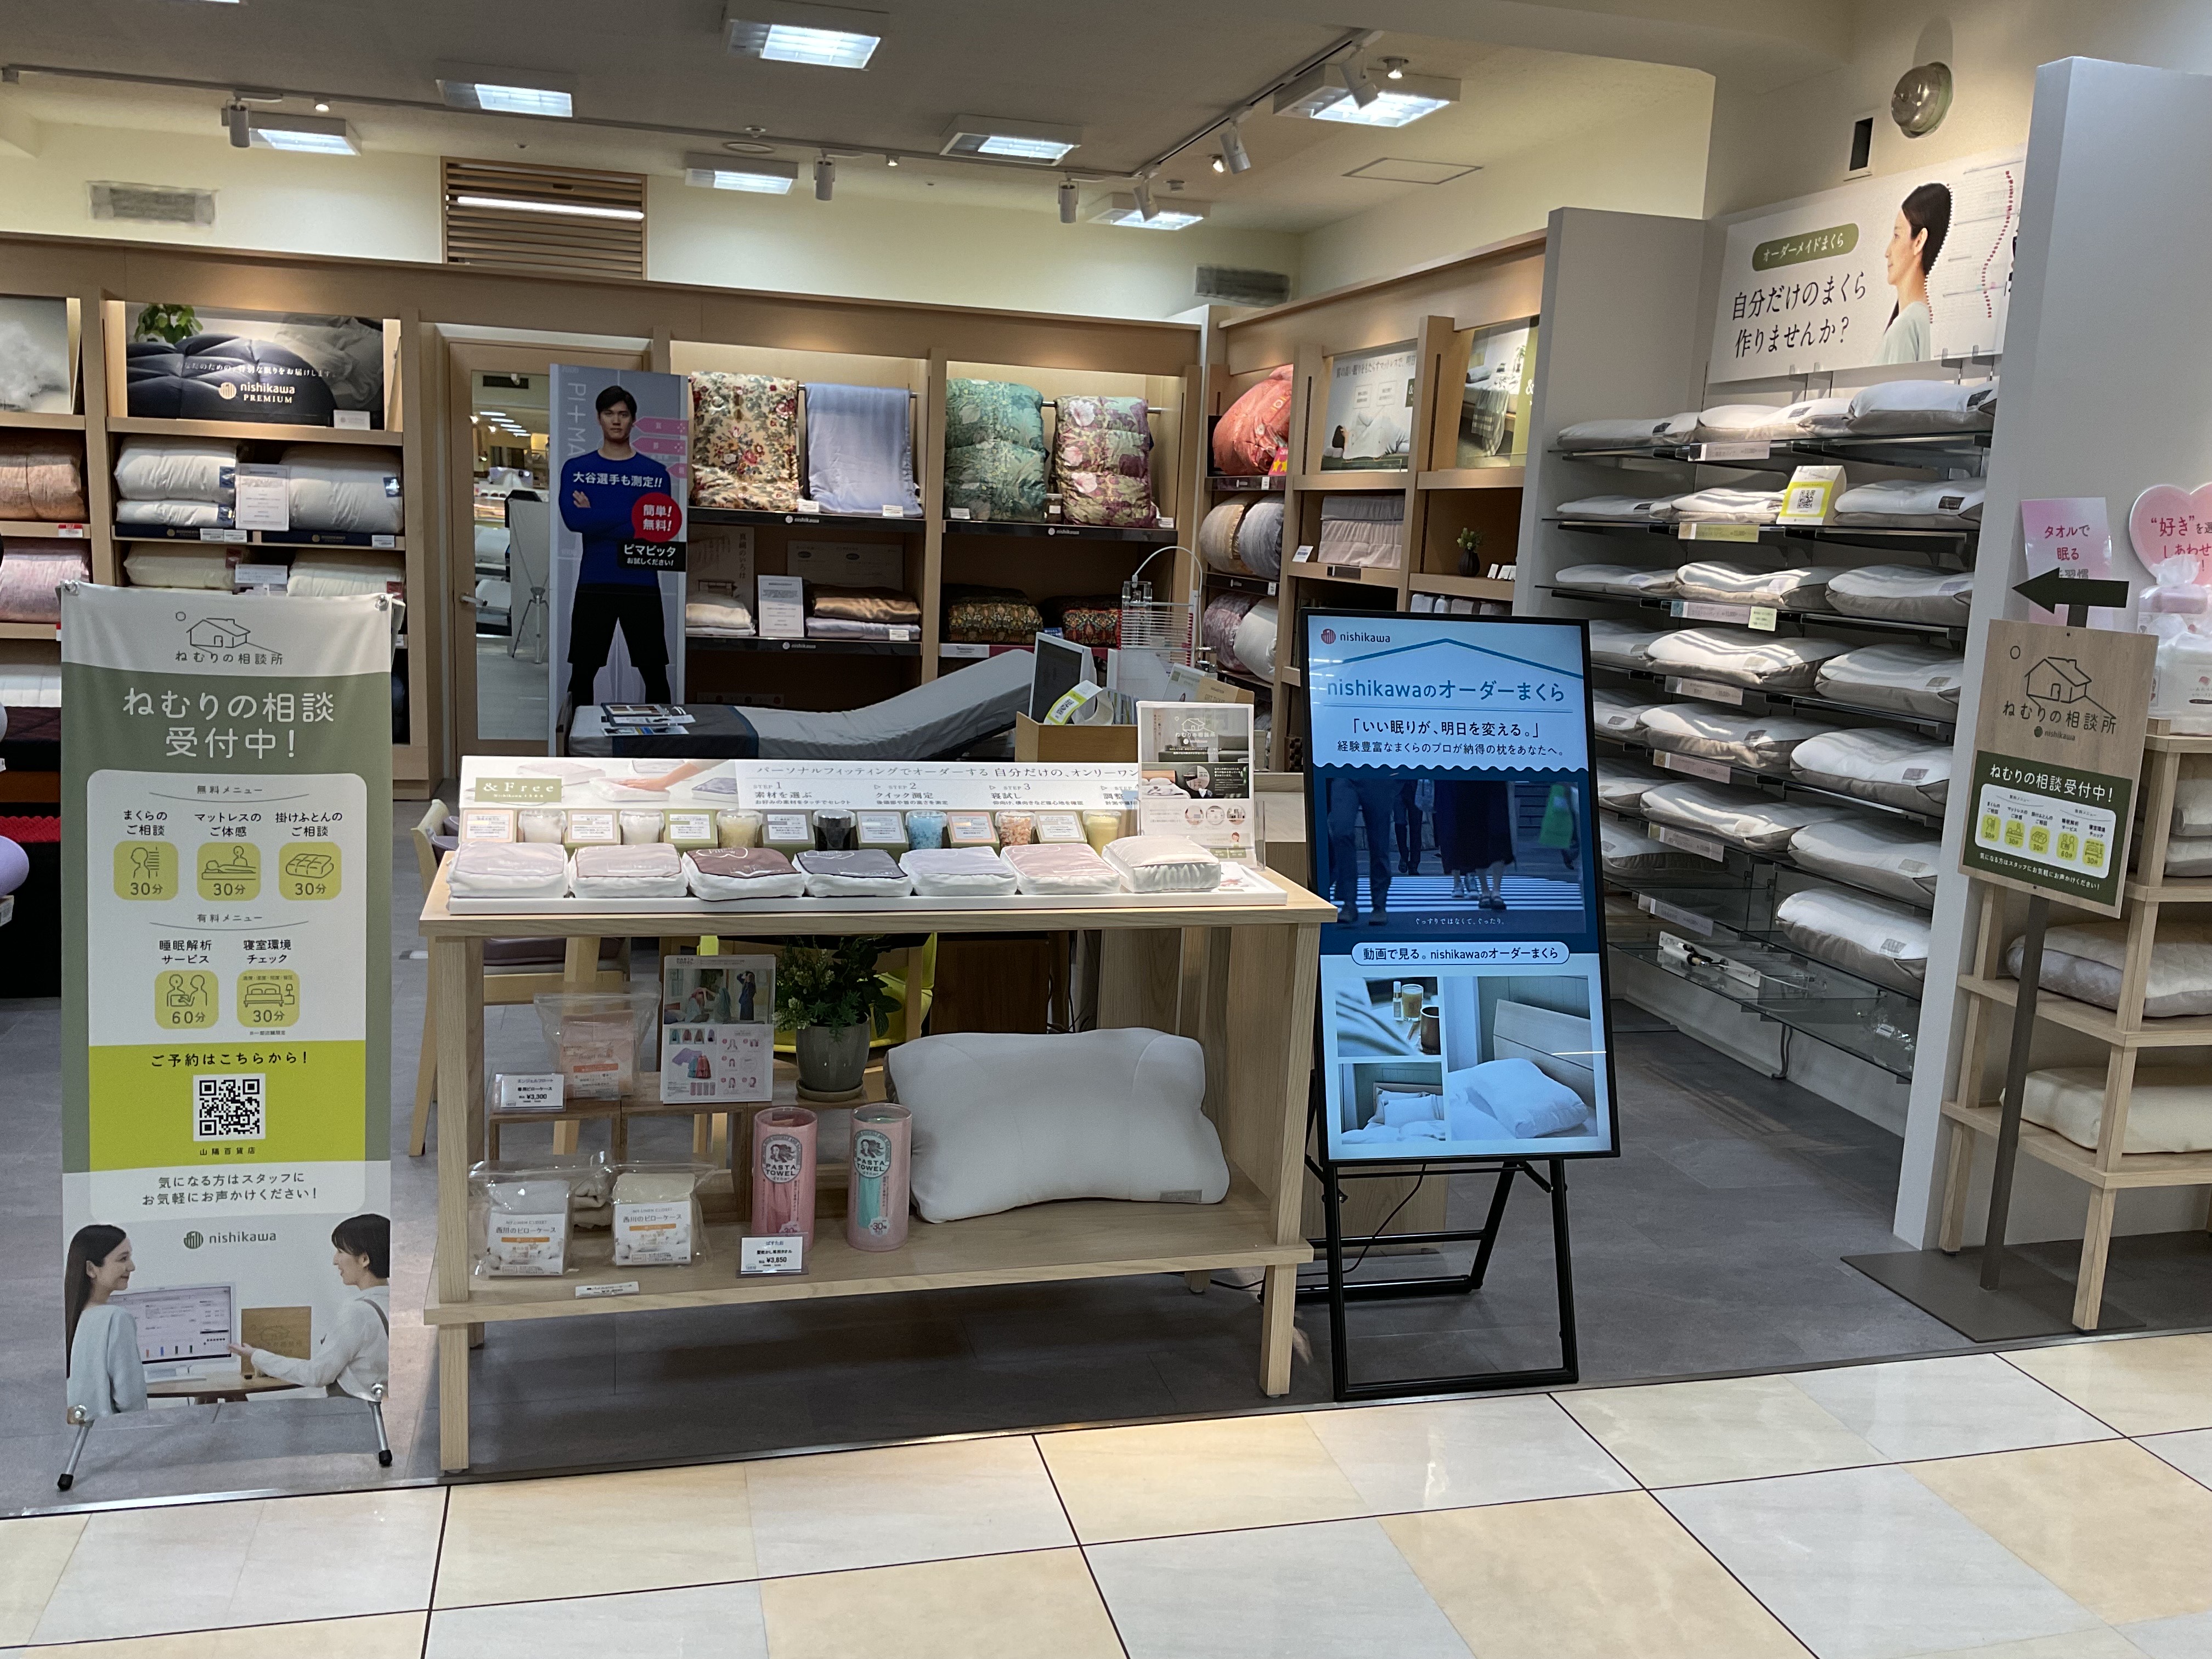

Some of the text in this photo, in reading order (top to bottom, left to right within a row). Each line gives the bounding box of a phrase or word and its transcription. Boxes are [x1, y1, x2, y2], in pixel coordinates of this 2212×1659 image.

[1762, 232, 1844, 263] オーダーメイドまくら
[1732, 271, 1867, 321] 自分だけのまくら
[240, 382, 296, 394] nishikawa
[243, 394, 293, 404] PREMIUM
[643, 504, 673, 517] 簡単!
[642, 518, 673, 532] 無料!
[2044, 524, 2090, 539] タオルで
[624, 544, 676, 557] ピマピッタ
[2056, 546, 2080, 561] 眠る
[1340, 631, 1391, 644] nishikawa
[175, 650, 284, 667] ねむりの相談所
[1327, 679, 1566, 702] nishikawaのオーダーまくら
[122, 687, 335, 724] ねむりの相談
[2002, 700, 2117, 735] ねむりの相談所
[1352, 718, 1541, 738] 「いい眠りが、明日を変える。」
[165, 726, 296, 759] 受付中!
[2044, 730, 2076, 742] nishikawa
[1337, 740, 1565, 757] 経験豊富なまくらのプロが納得の枕をあなたへ。
[757, 766, 989, 777] パーソナルフィッティングでオーダーする
[196, 785, 263, 795] 無料メニュー
[483, 781, 554, 792] & Free
[776, 781, 782, 789] 1
[910, 782, 917, 790] 2
[1024, 782, 1031, 791] 3
[123, 809, 168, 822] まくらの
[194, 811, 262, 823] マットレスの
[275, 811, 343, 823] 掛けふとんの
[2007, 806, 2028, 815] マットレスの
[126, 825, 166, 837] ご相談
[209, 825, 247, 838] ご体感
[291, 825, 329, 838] ご相談
[130, 882, 163, 896] 30分
[213, 883, 246, 896] 30分
[295, 882, 328, 896] 30分
[196, 913, 263, 923] 有料メニュー
[159, 939, 213, 952] 睡眠解析
[242, 939, 292, 952] 寝室環境
[161, 954, 210, 965] サービス
[246, 953, 288, 965] チェック
[1363, 947, 1559, 961] 動画で見る。nishikawaのオーダーまくら
[172, 1011, 206, 1024] 60分
[253, 1009, 285, 1023] 30分
[151, 1051, 308, 1068] ご予約はこちらから!
[199, 1147, 257, 1156] 山陽百貨店
[857, 1157, 885, 1166] PASTA
[857, 1163, 884, 1172] TOWEL
[157, 1171, 305, 1189] 気になる方はスタッフに
[142, 1187, 317, 1207] お気軽にお声かけください!
[623, 1214, 682, 1223] 西川のピローケース
[209, 1231, 277, 1245] nishikawa
